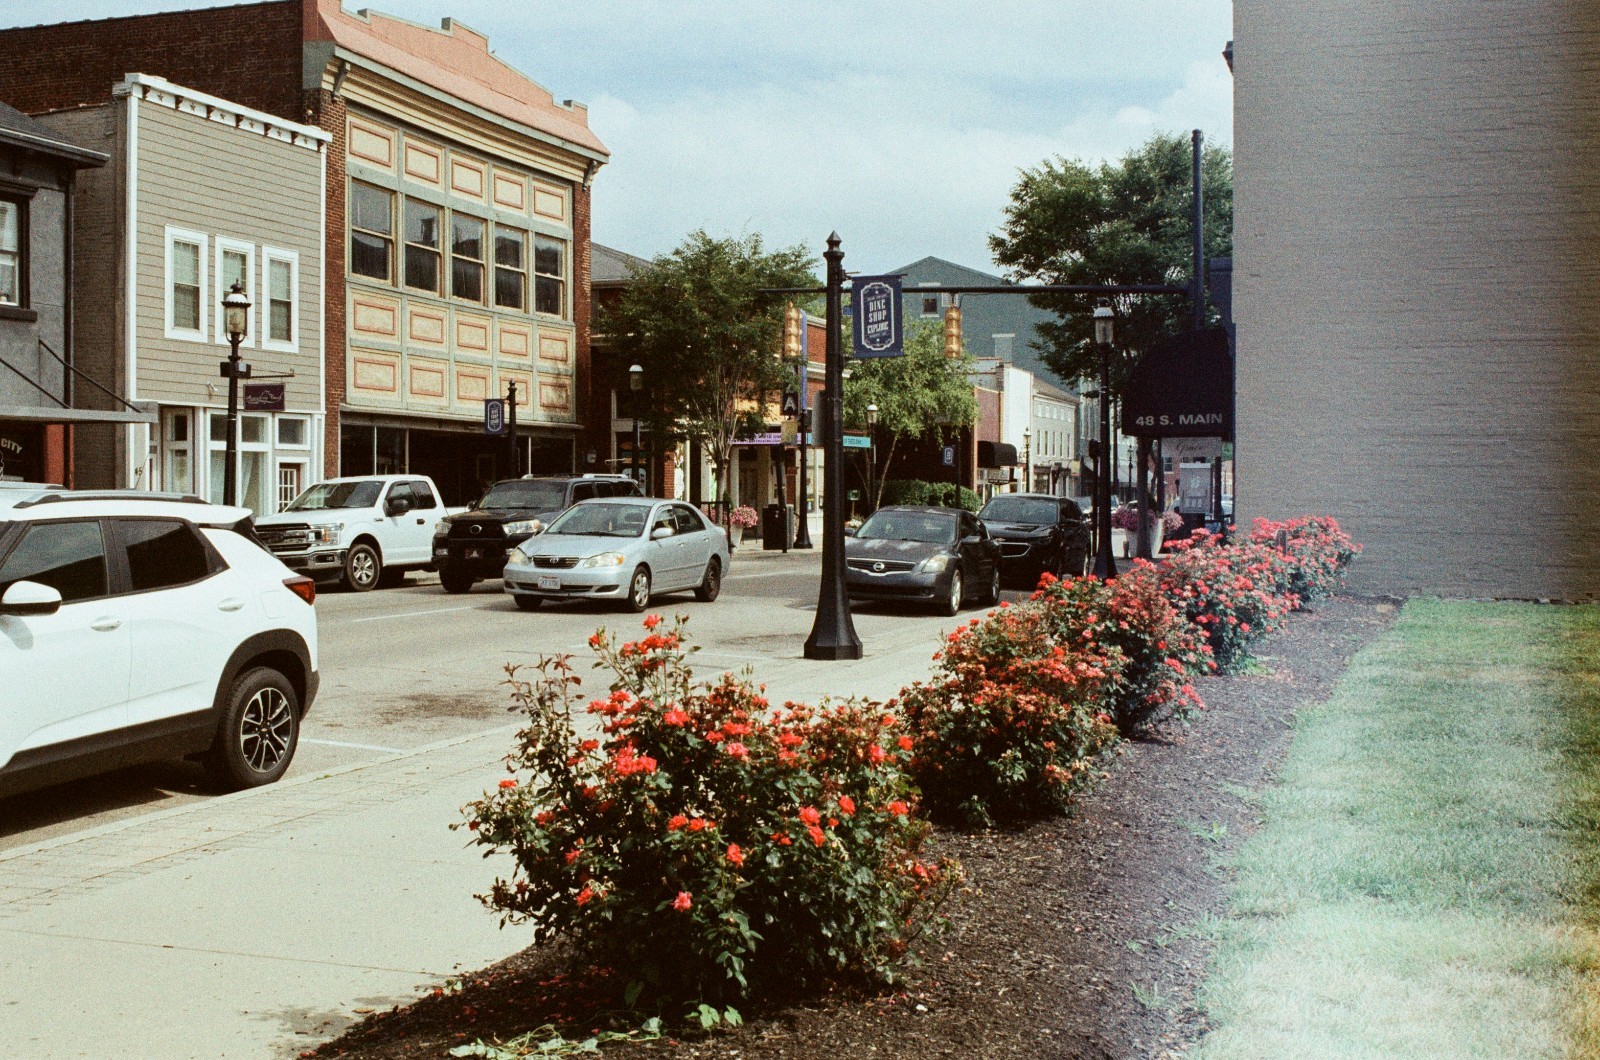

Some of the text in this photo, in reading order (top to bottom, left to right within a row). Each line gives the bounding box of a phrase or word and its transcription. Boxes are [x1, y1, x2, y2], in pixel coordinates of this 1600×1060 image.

[869, 299, 886, 311] DINE
[868, 310, 887, 323] SHOP
[1136, 413, 1222, 426] 48 S. MAIN
[1, 438, 23, 454] CITY
